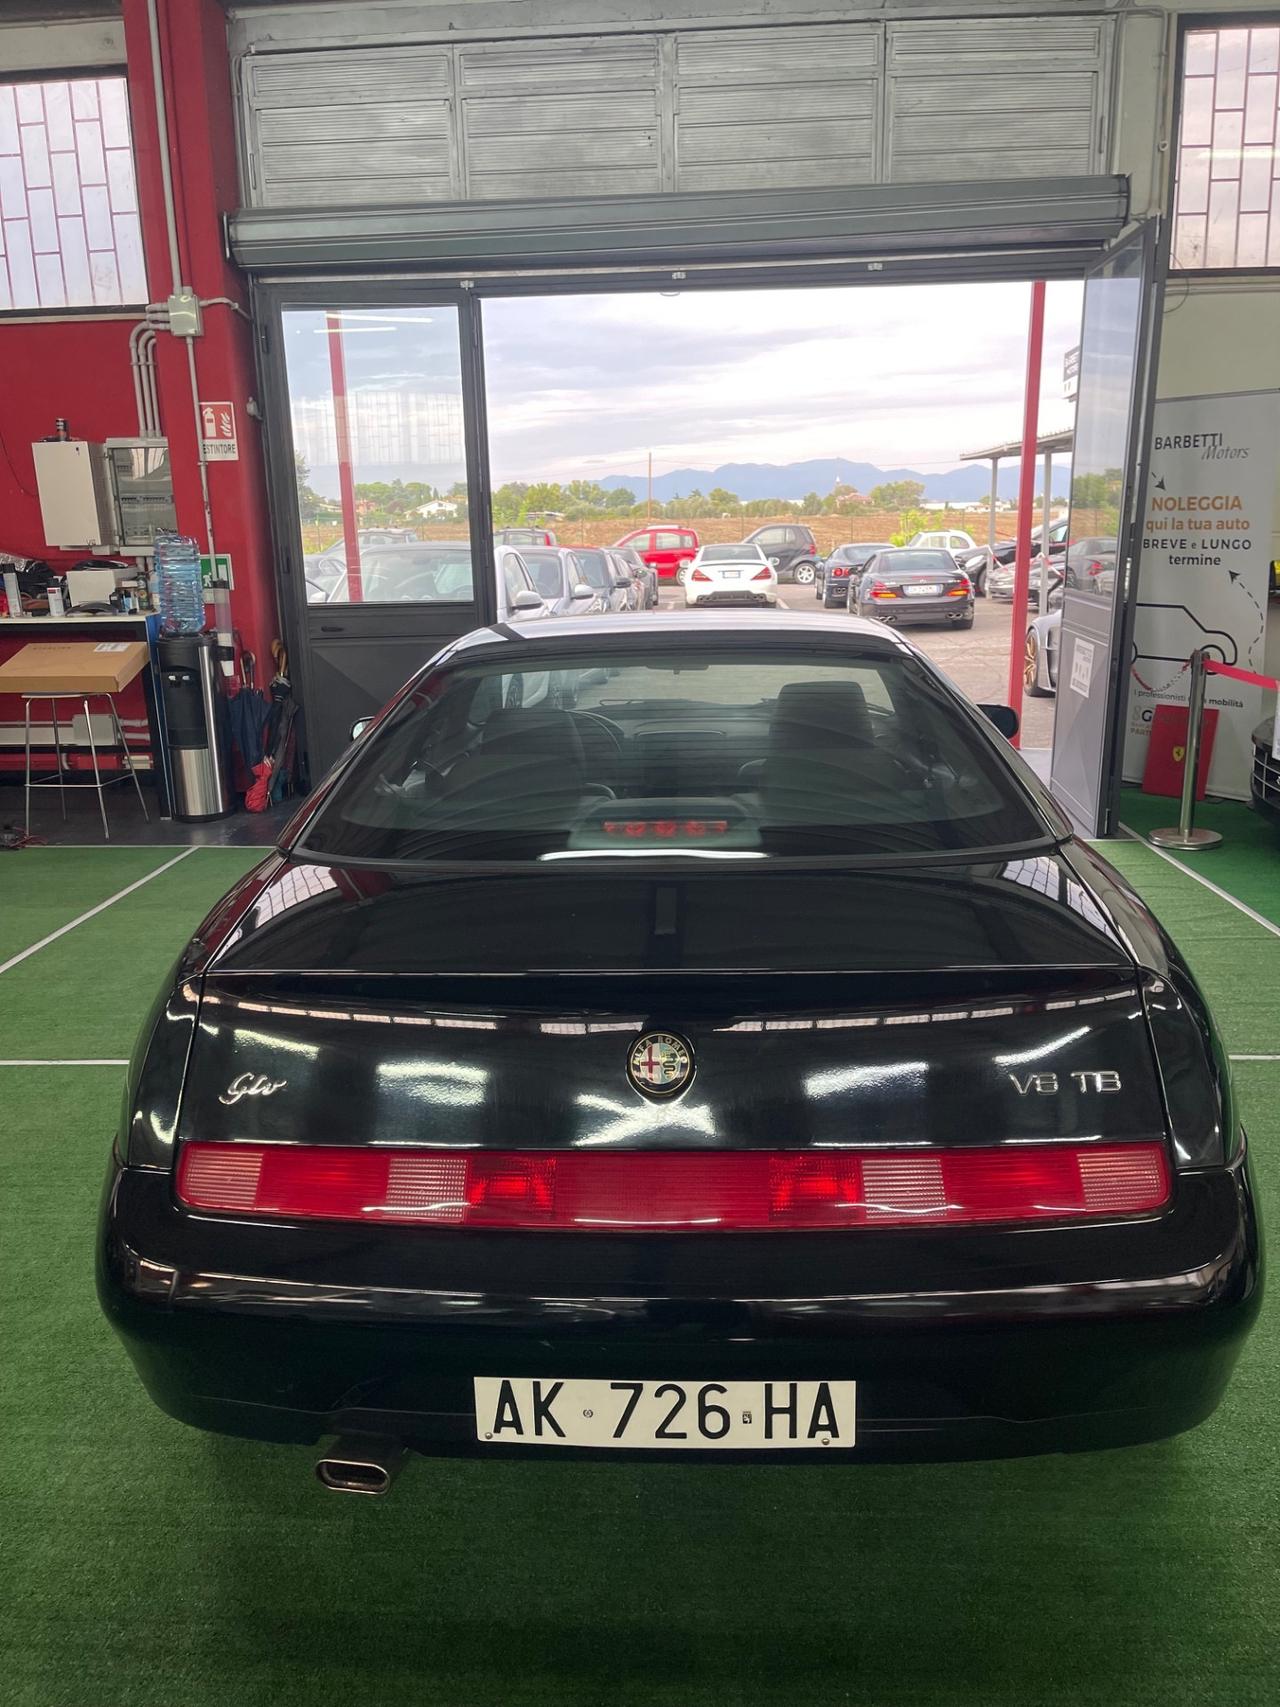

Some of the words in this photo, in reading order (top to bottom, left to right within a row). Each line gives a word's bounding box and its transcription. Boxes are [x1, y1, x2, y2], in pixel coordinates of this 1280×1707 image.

[202, 443, 236, 454] ESTINTORE
[1154, 433, 1223, 450] BARBETTI
[1201, 446, 1250, 460] Motors
[1151, 496, 1243, 512] NOLEGGIA
[1146, 517, 1168, 533] qui
[1171, 517, 1184, 530] la
[1188, 518, 1212, 531] tua
[1216, 518, 1250, 530] auto
[1143, 539, 1187, 549] BREVE
[1191, 542, 1197, 550] e
[1201, 539, 1252, 550] LUNGO
[1168, 554, 1222, 566] termine
[1138, 690, 1187, 701] professionisti
[1208, 698, 1244, 708] mobilità
[657, 1035, 688, 1064] ROMEO
[1070, 1070, 1122, 1094] TB
[493, 1379, 567, 1438] AK
[609, 1382, 731, 1440] 726
[763, 1381, 841, 1440] HA
